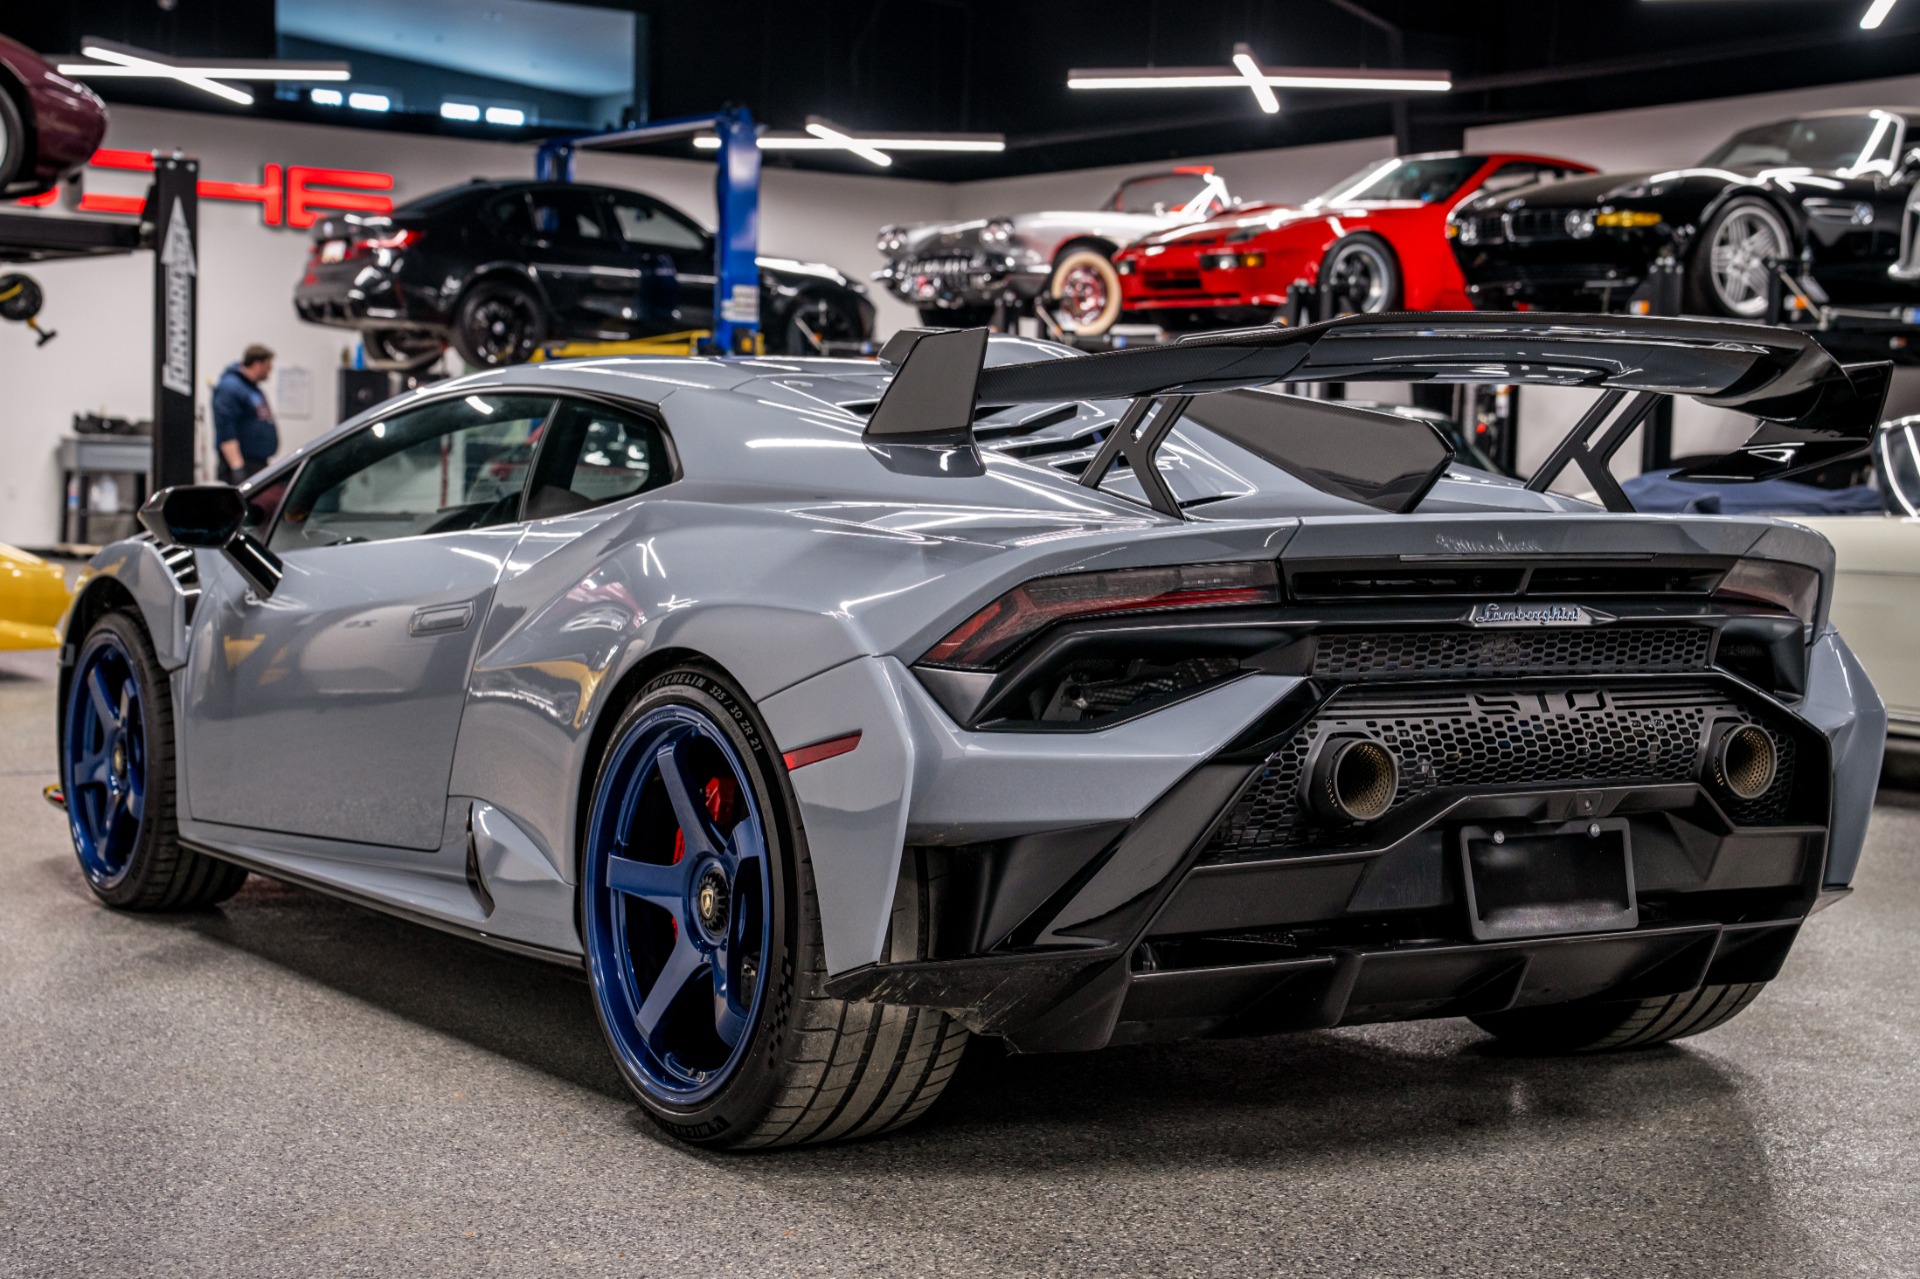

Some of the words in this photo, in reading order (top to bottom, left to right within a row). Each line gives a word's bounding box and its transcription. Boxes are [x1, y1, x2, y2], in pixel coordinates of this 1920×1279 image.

[16, 148, 393, 229] CHE
[1475, 602, 1583, 625] Lamborghini
[650, 673, 707, 691] MICHELIN
[709, 685, 727, 700] 325
[730, 705, 743, 719] 30
[740, 719, 754, 736] ZR
[750, 738, 762, 751] 21
[1473, 690, 1607, 715] STO
